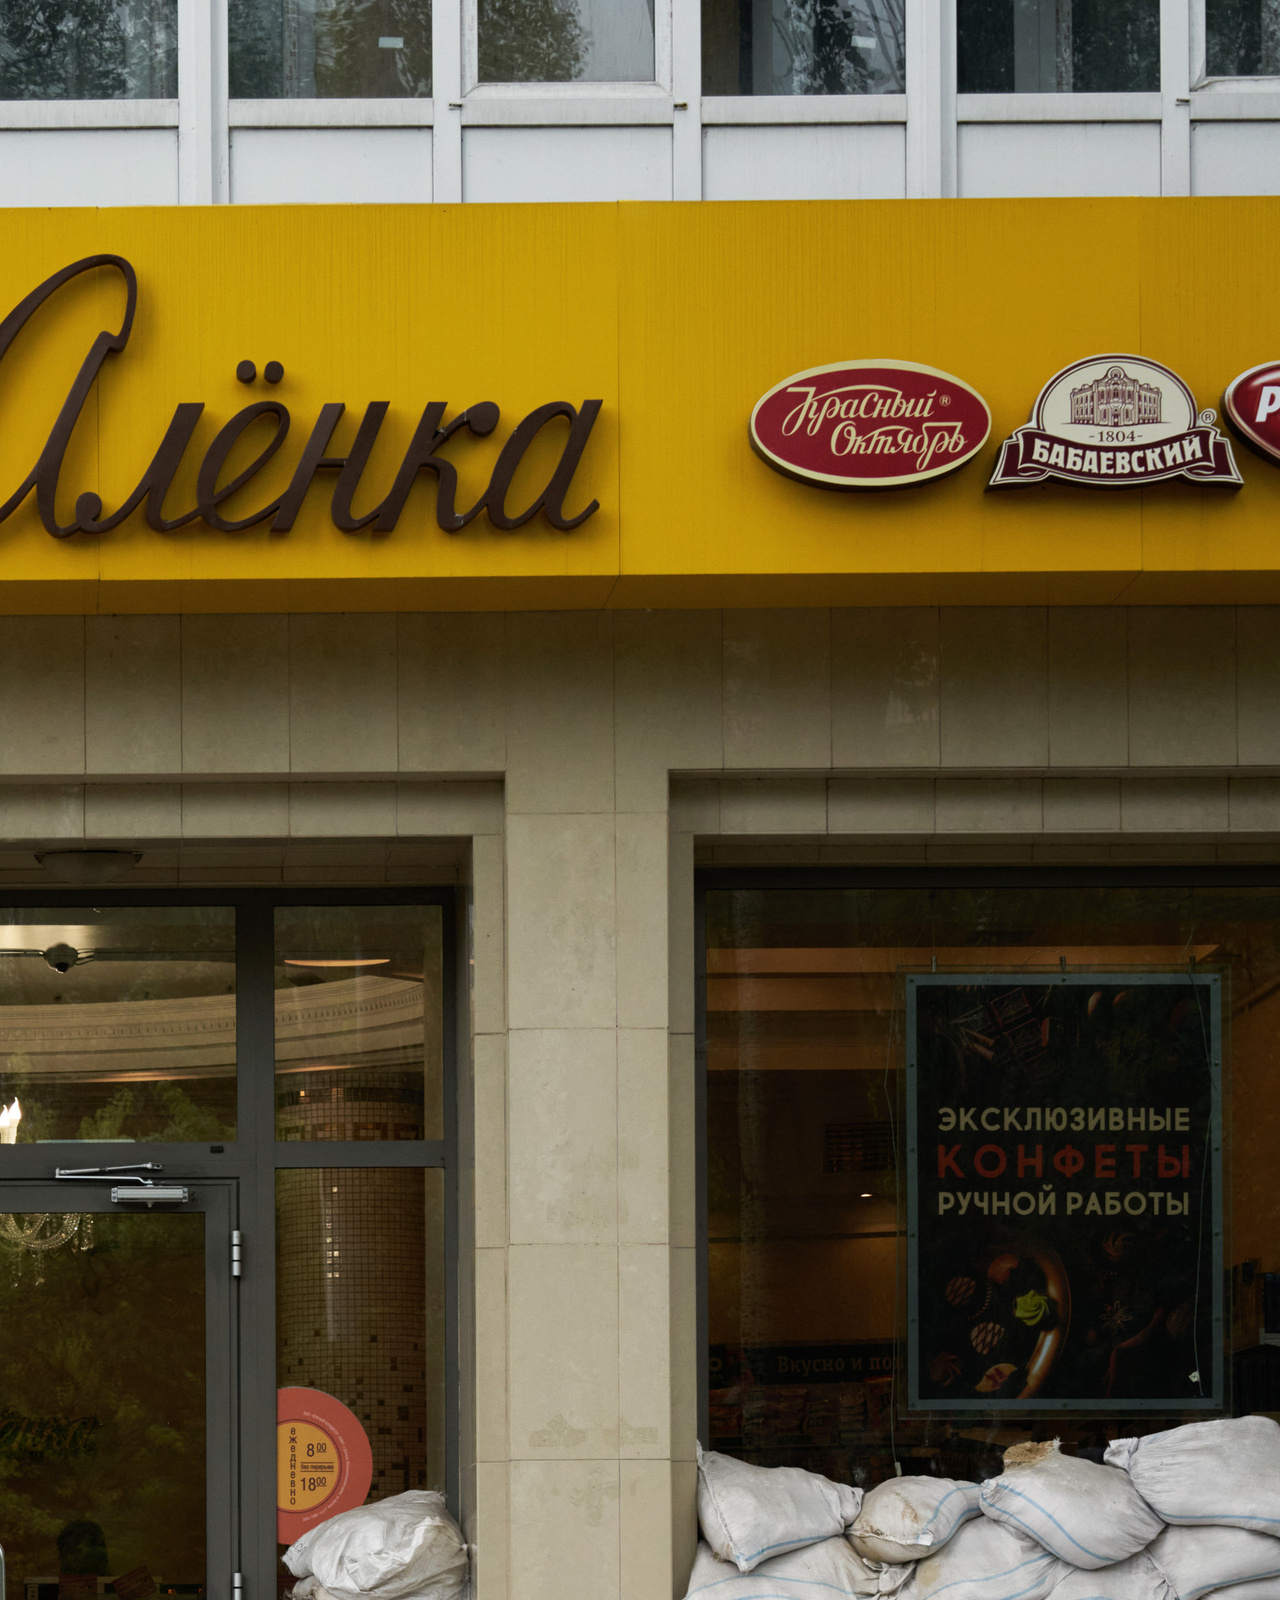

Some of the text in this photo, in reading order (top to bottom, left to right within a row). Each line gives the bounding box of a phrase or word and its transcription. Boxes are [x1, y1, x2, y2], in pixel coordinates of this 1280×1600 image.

[782, 385, 937, 436] Красный
[831, 420, 967, 471] Октябрь
[1031, 435, 1204, 475] БАБАЕВСКИЙ
[937, 1106, 1191, 1132] ЭКСКЛЮЗИВНЫЕ
[937, 1144, 1191, 1179] КОНФЕТЫ
[937, 1185, 1190, 1216] РУЧНОЙ РАБОТЫ
[776, 1355, 846, 1377] Вкусно
[288, 1427, 297, 1506] ежедневно
